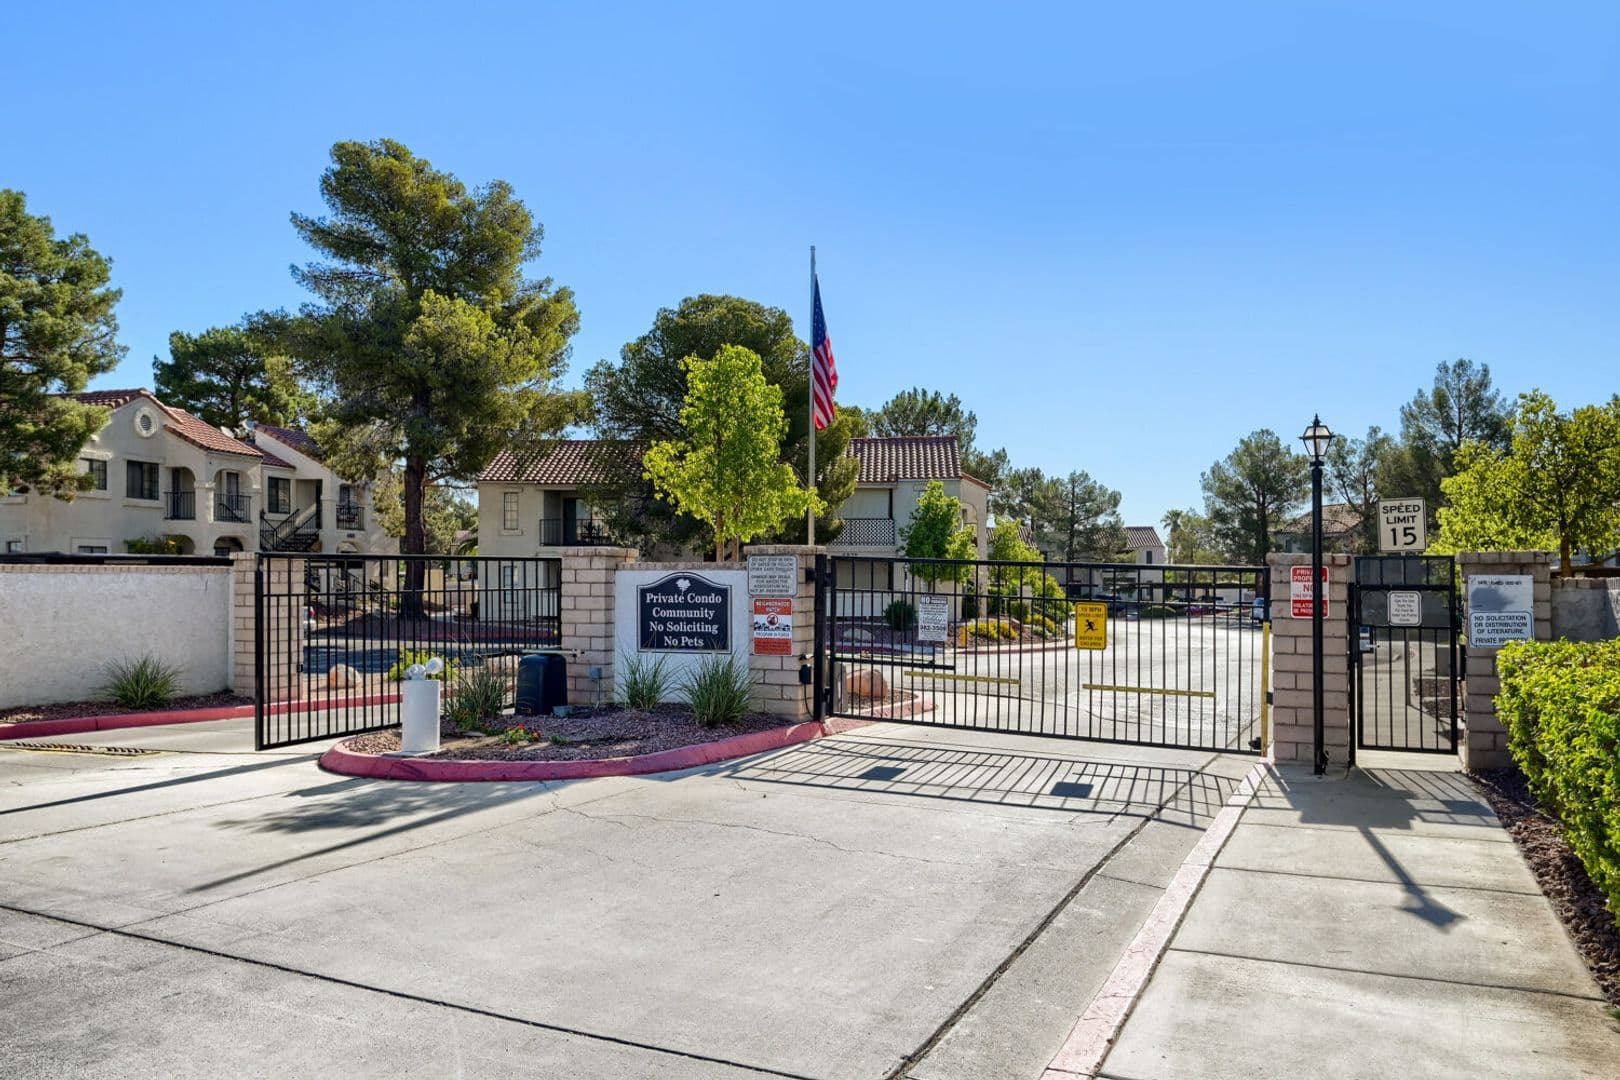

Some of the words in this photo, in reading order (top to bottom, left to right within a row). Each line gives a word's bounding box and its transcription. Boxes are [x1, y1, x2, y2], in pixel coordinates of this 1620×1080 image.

[1382, 504, 1421, 514] SPEED
[1386, 515, 1416, 524] LIMIT
[1391, 527, 1417, 546] 15
[646, 593, 684, 603] Private
[687, 593, 722, 603] Condo
[652, 607, 715, 620] Community
[649, 621, 664, 632] No
[666, 621, 719, 634] Soliciting
[664, 636, 678, 646] No
[681, 636, 704, 646] Pets
